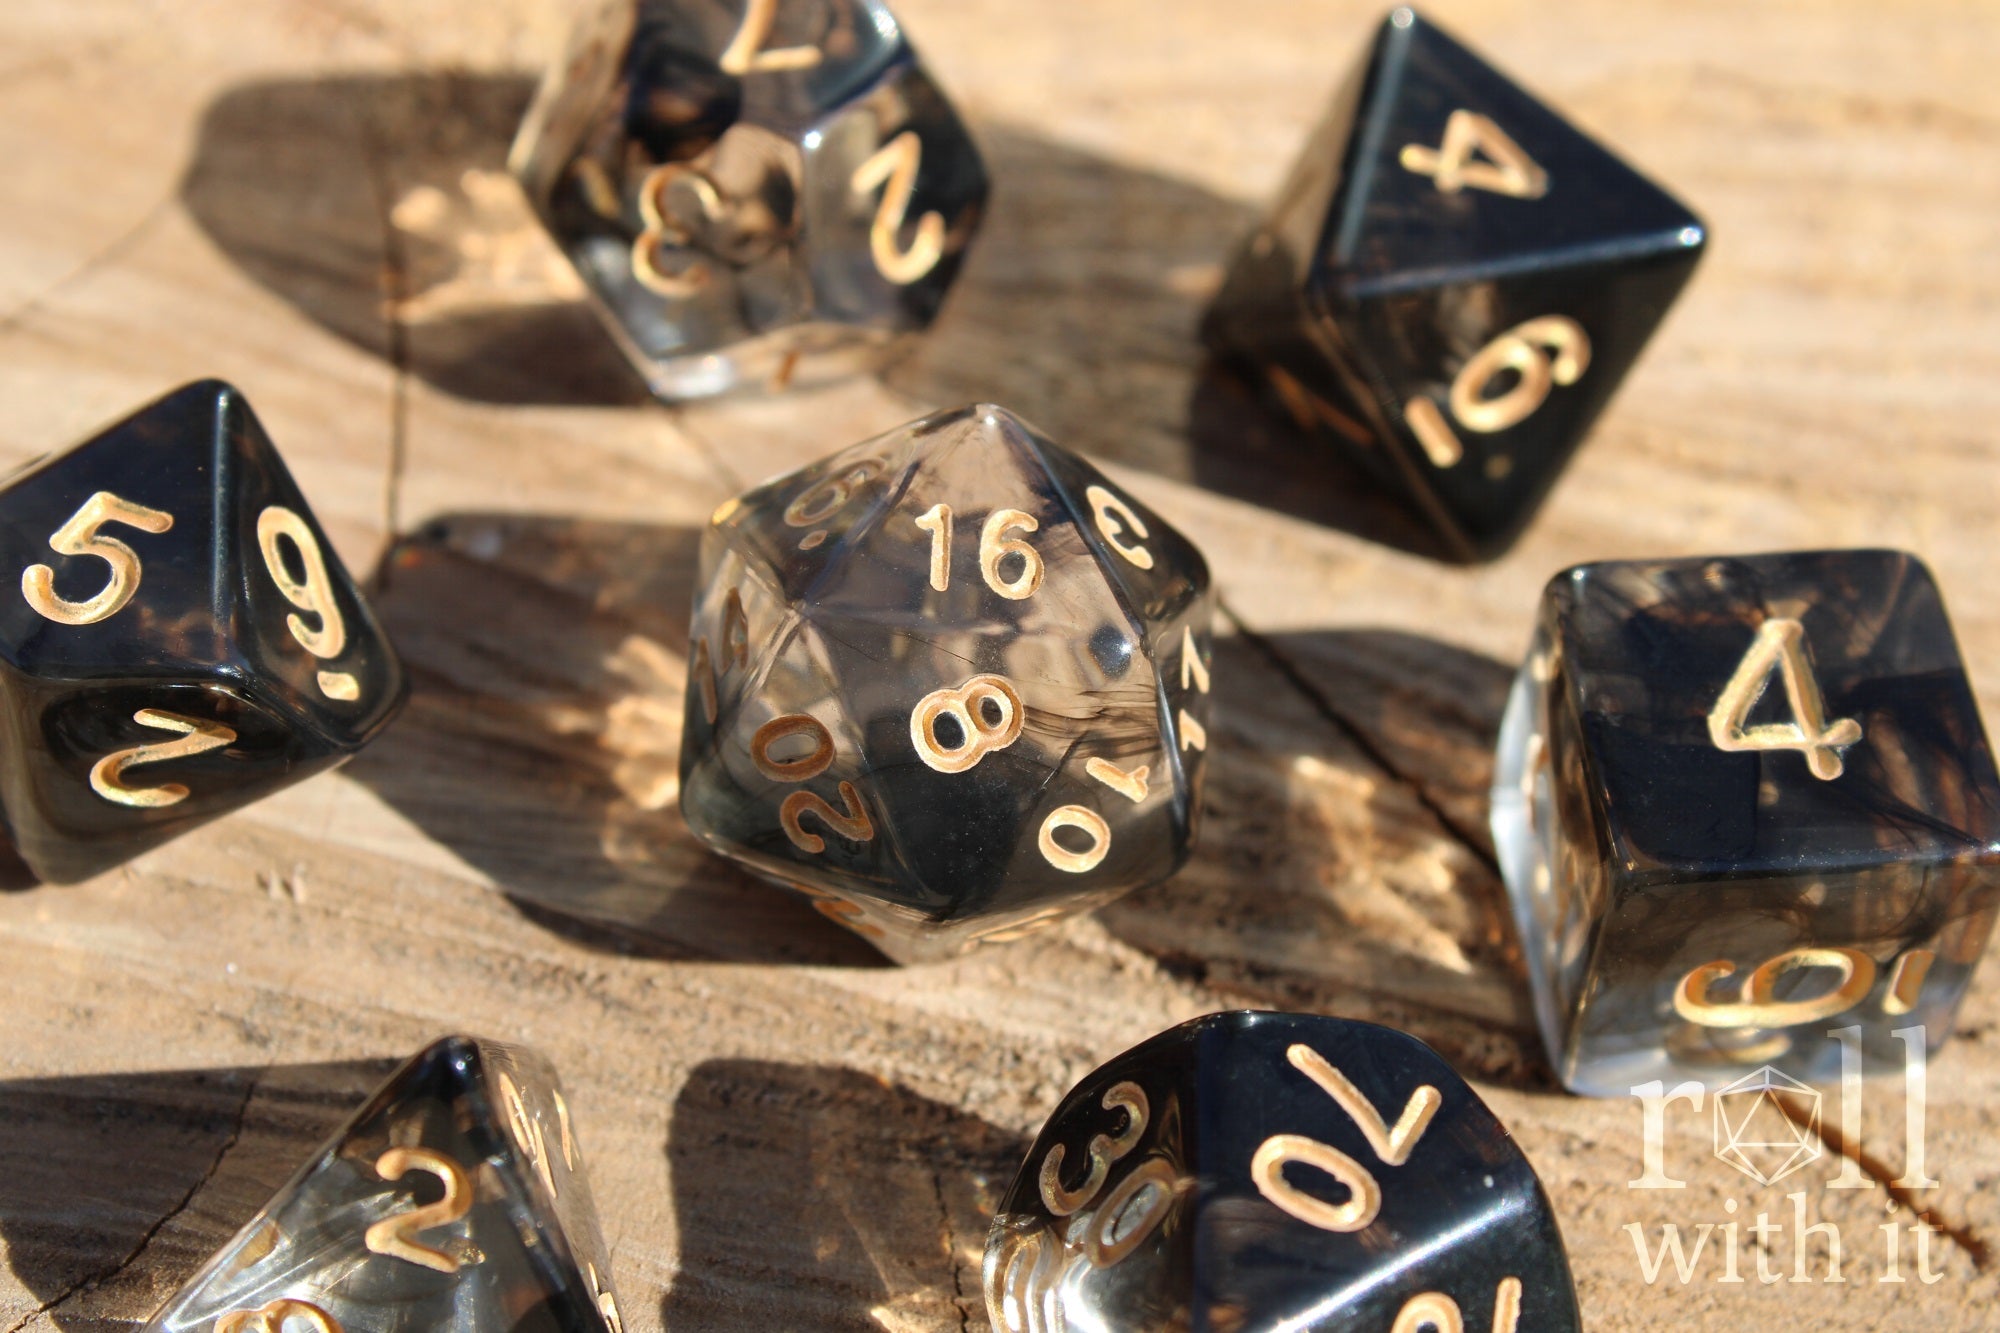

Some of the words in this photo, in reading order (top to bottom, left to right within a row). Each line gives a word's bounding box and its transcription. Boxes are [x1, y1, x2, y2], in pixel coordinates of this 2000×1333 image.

[851, 131, 946, 285] 2
[1399, 109, 1550, 200] 4
[631, 163, 730, 297] 3
[21, 491, 174, 626] 5
[915, 503, 1045, 600] 16
[1086, 485, 1154, 570] 3
[89, 707, 238, 808] 2
[910, 674, 1025, 773] 8
[1707, 618, 1862, 781] 4
[750, 713, 874, 854] 20
[1039, 756, 1149, 872] 10
[1038, 1081, 1176, 1268] 30
[1251, 1043, 1442, 1232] 70
[365, 1146, 473, 1273] 2
